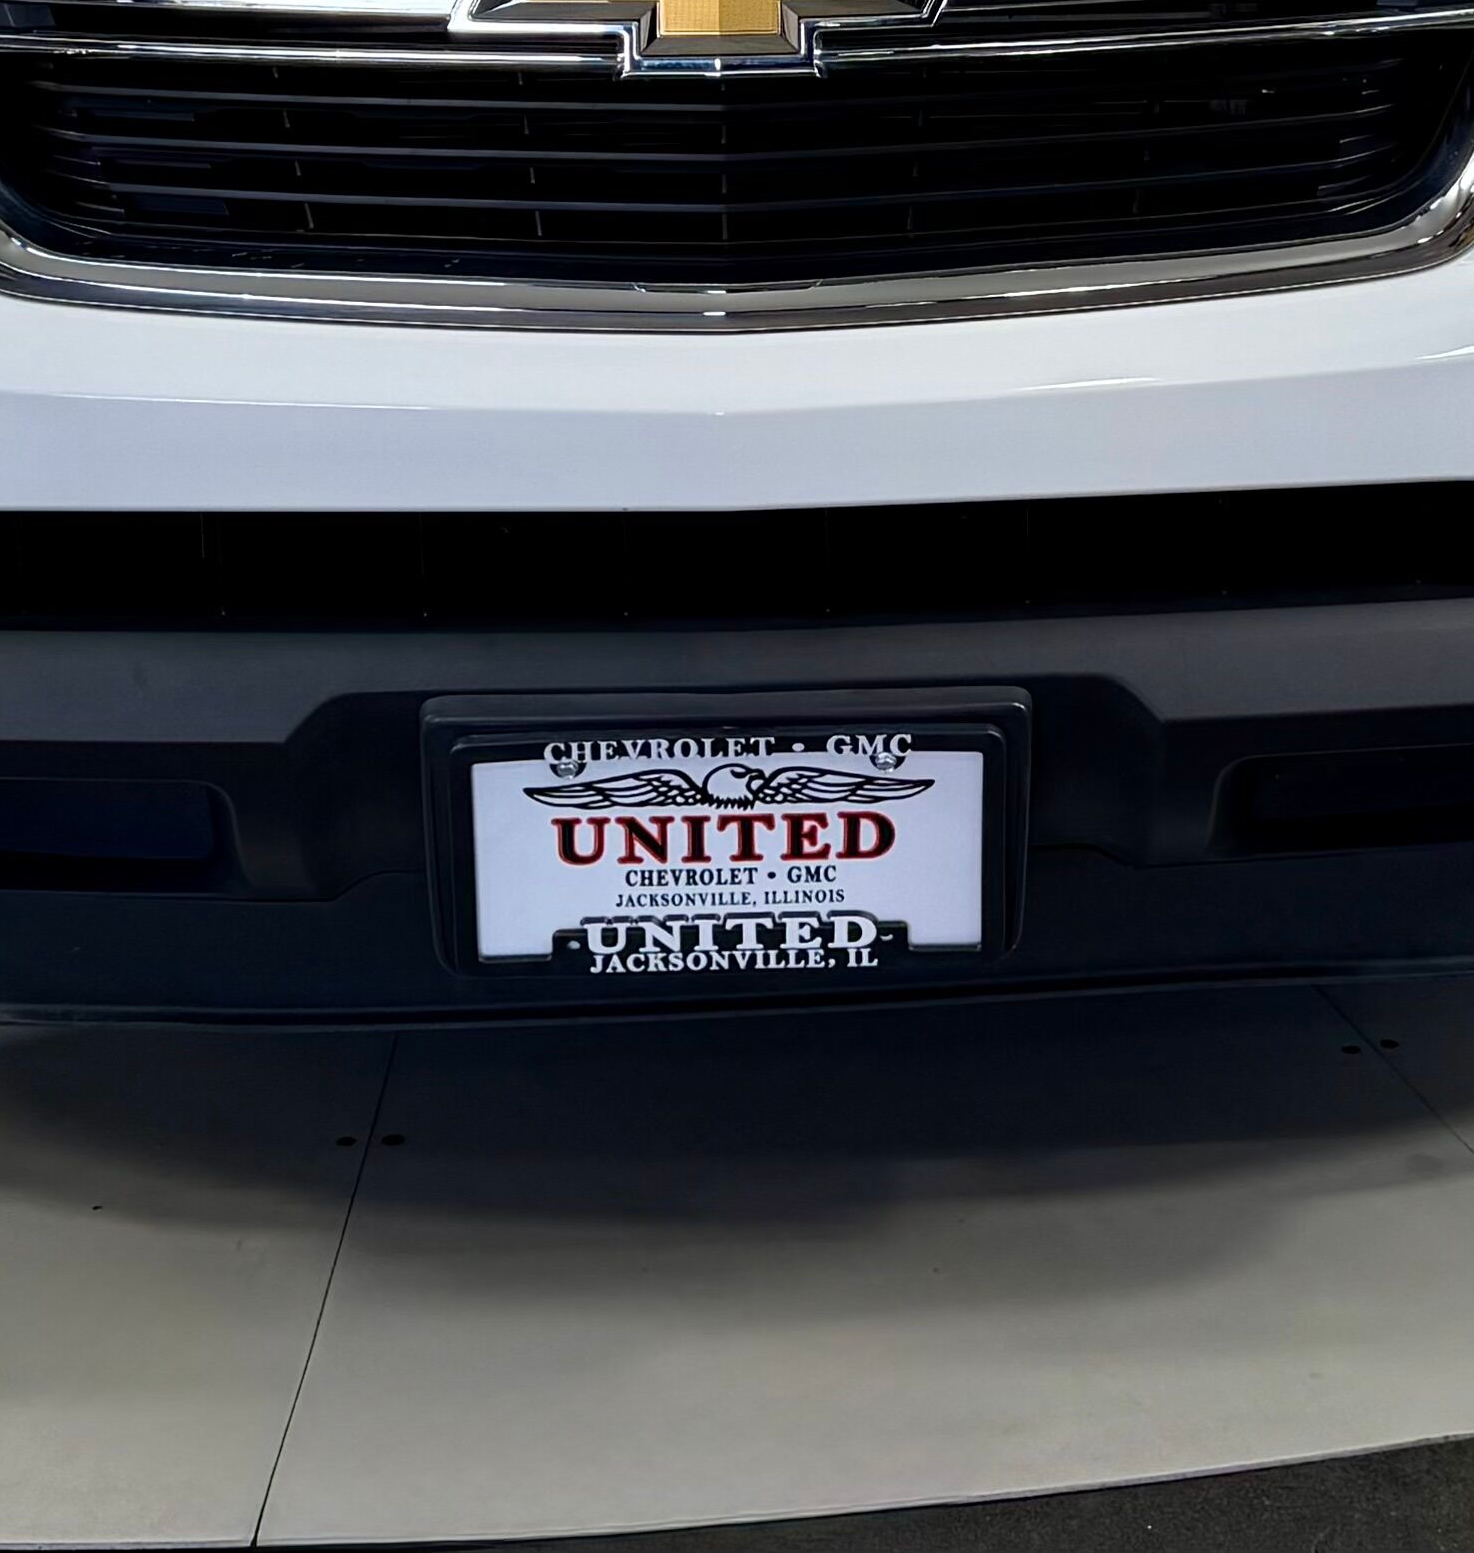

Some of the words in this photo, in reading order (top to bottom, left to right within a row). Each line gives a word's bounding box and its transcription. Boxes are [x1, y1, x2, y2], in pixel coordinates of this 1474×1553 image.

[543, 736, 776, 763] CHEVROLET
[826, 733, 913, 758] GMC
[550, 810, 896, 866] UNITED
[624, 866, 759, 887] CHEVROLET
[786, 864, 838, 884] GMC
[615, 891, 758, 908] JACKSONVILLE,
[763, 888, 845, 906] ILLINOIS
[582, 914, 878, 955] UNITED
[589, 948, 837, 974] JACKSONVILLE,
[846, 947, 879, 968] IL
